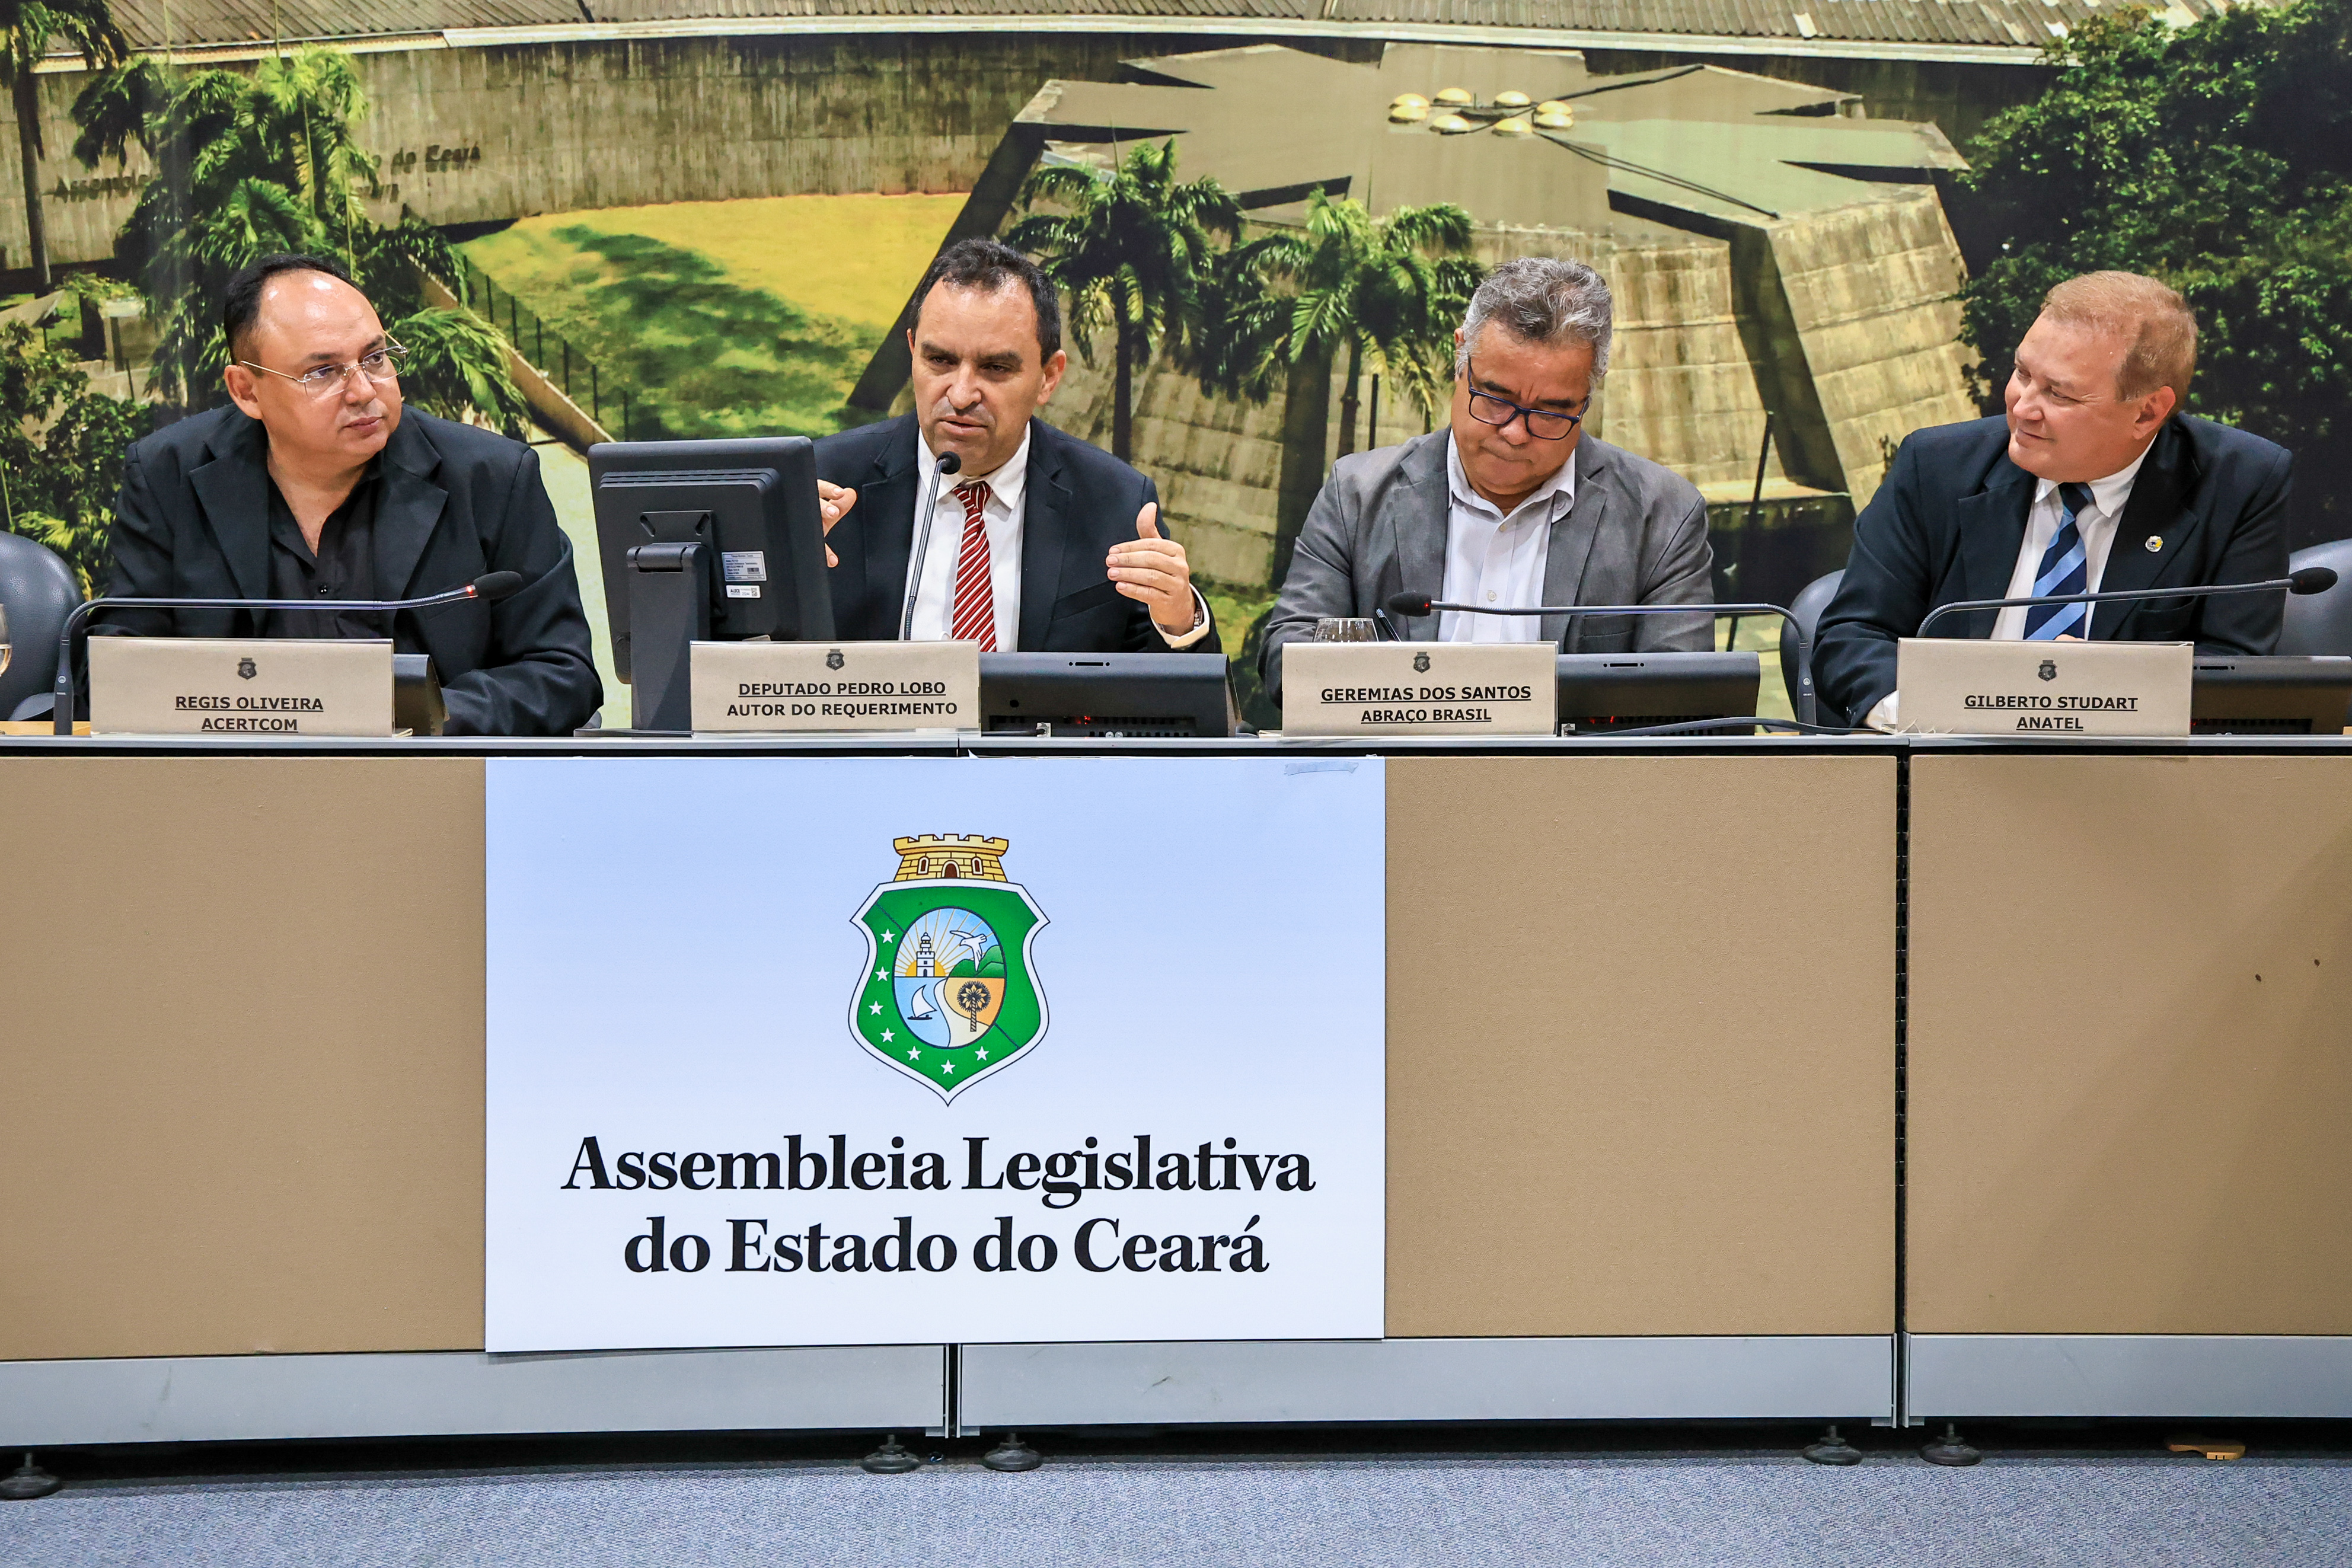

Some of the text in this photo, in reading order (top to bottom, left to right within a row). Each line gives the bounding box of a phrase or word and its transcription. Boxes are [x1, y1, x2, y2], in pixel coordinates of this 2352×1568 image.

[739, 682, 946, 695] DEPUTADO PEDRO LOBO
[1321, 686, 1531, 701] GEREMIAS DOS SANTOS
[175, 696, 323, 710] REGIS OLIVEIRA
[727, 702, 958, 718] AUTOR DO REQUERIMENTO
[1965, 695, 2139, 710] GILBERTO STUDART
[1362, 708, 1492, 724] ABRAÇO BRASIL
[2016, 717, 2083, 729] ANATEL
[202, 718, 298, 730] ACERTCOM
[561, 1134, 1316, 1209] Assembleia Legislativa
[624, 1214, 1270, 1273] do Estado do Ceará
